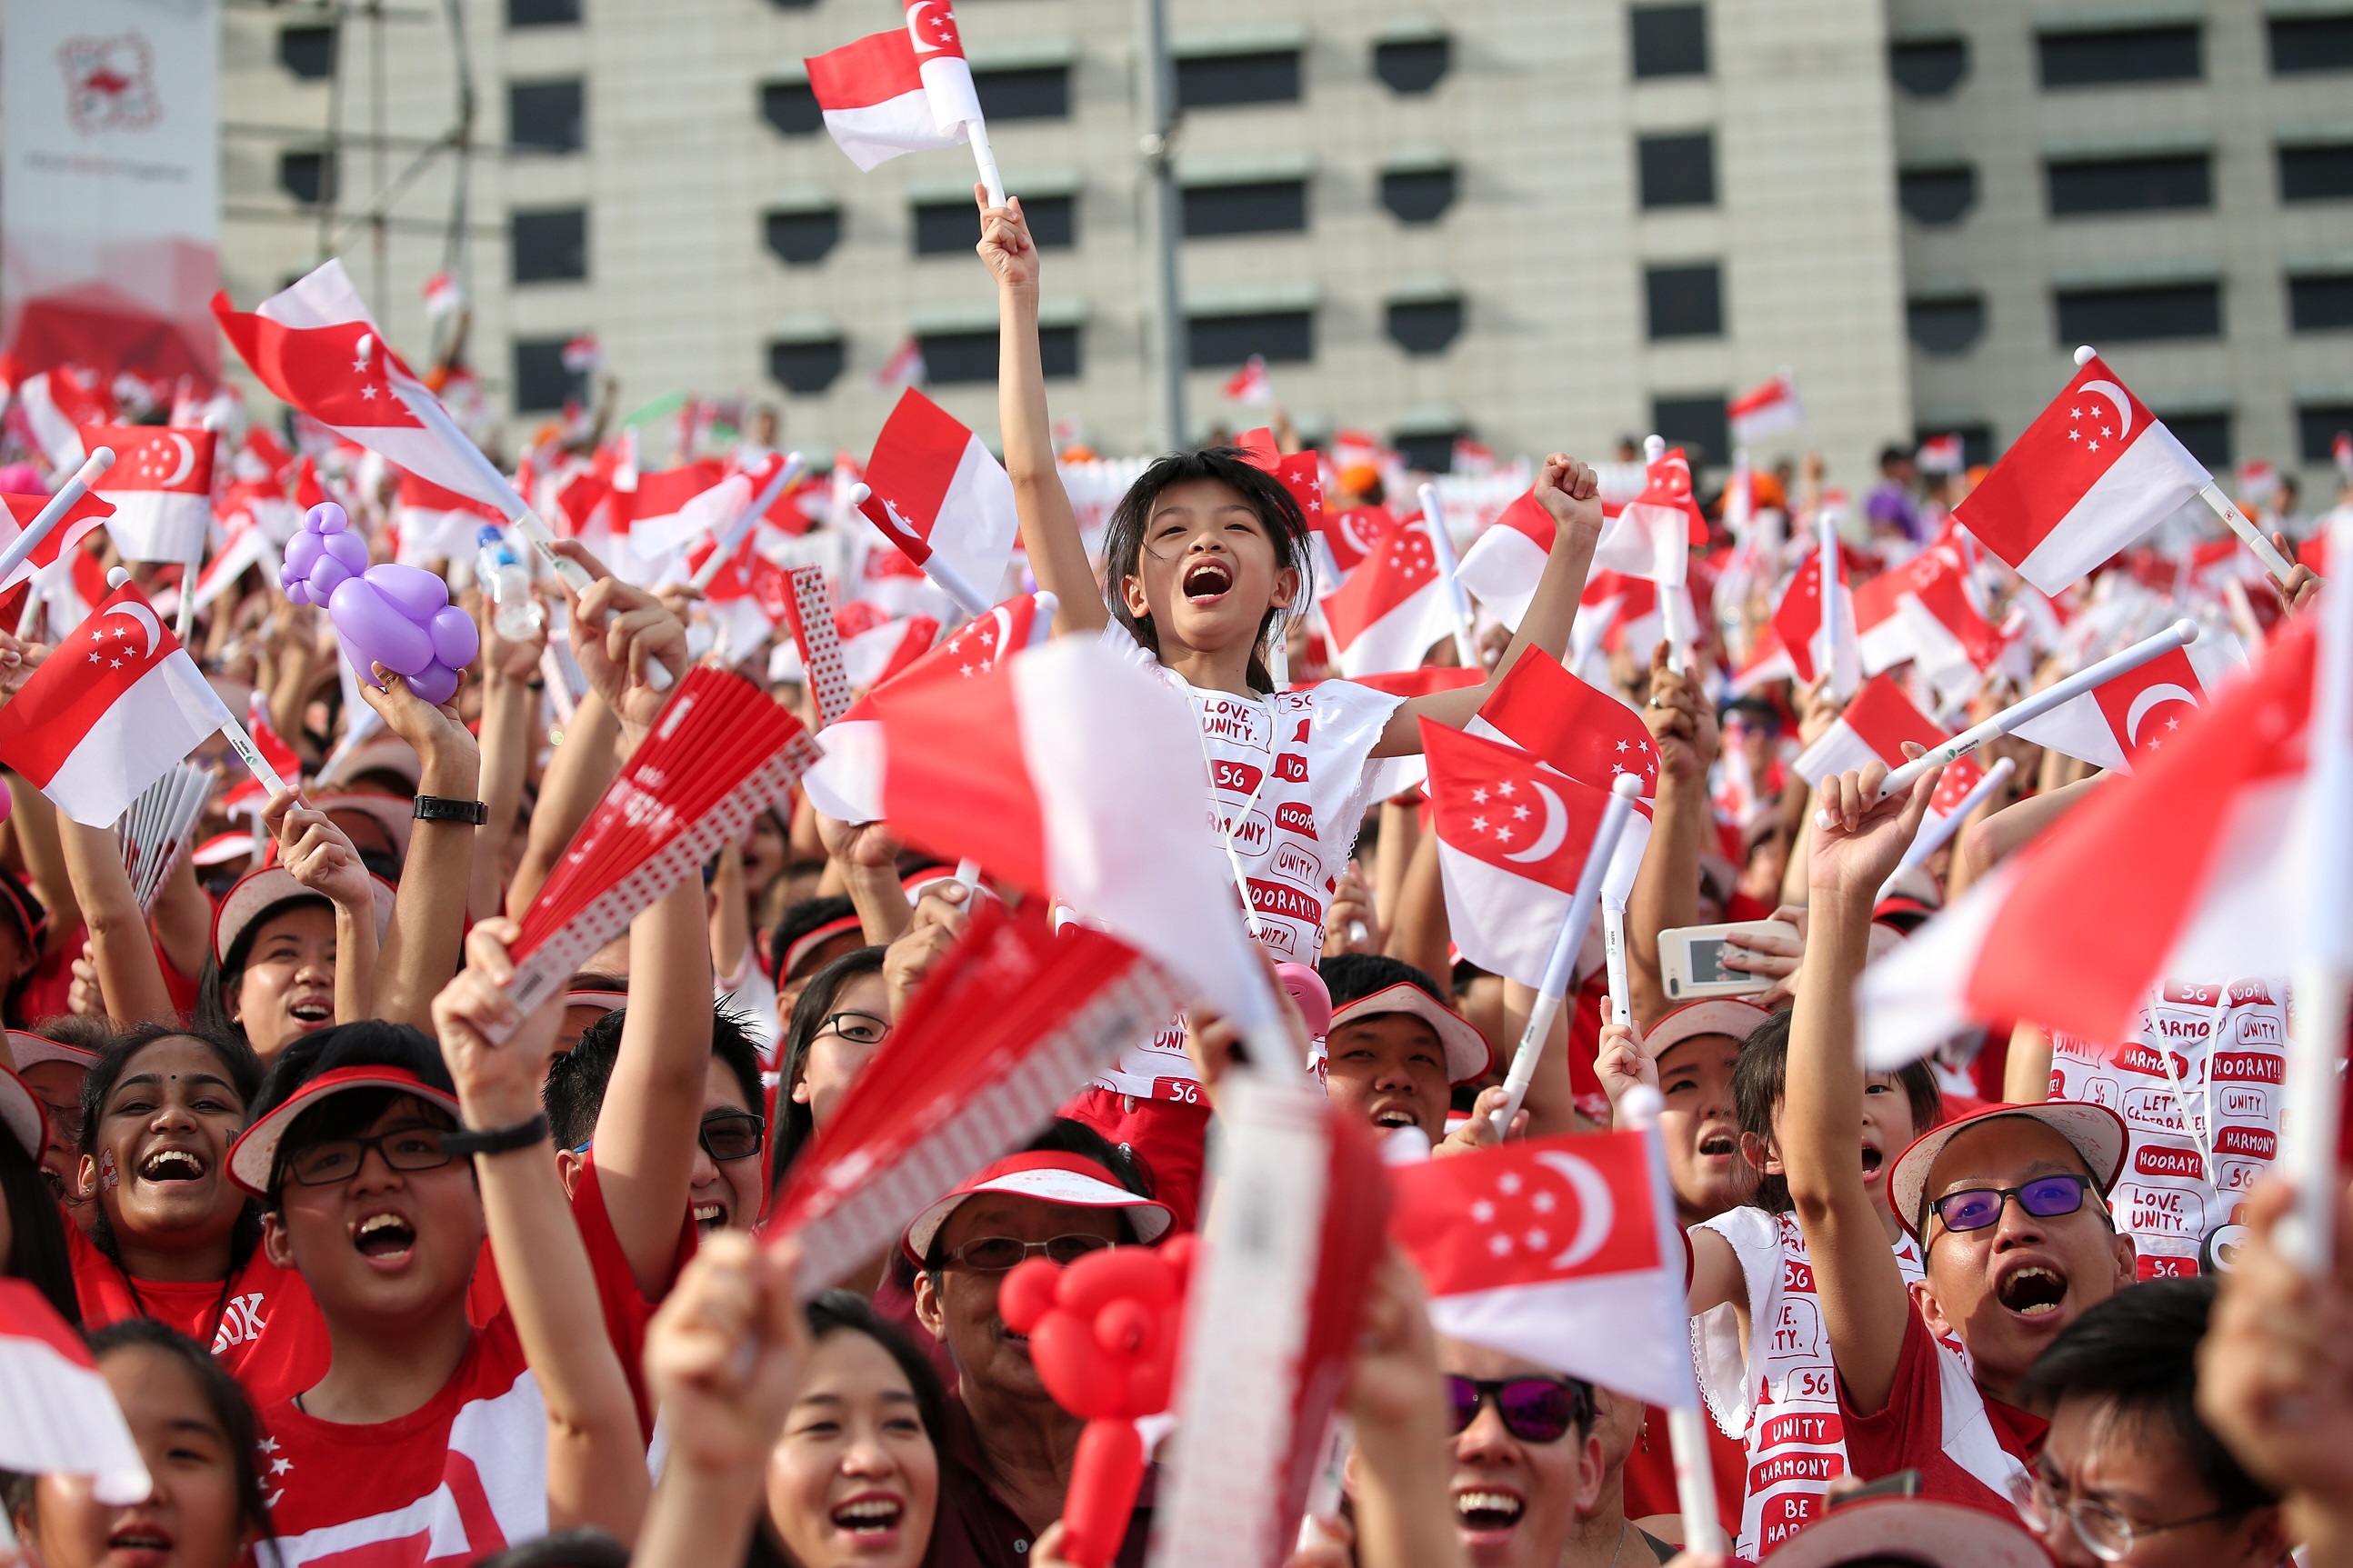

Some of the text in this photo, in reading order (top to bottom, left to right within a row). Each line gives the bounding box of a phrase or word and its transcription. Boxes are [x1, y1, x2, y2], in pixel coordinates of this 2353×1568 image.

[1205, 699, 1253, 724] LOVE.
[1202, 716, 1257, 742] UNITY.
[1957, 738, 1980, 754] sembcorp
[1217, 765, 1245, 787] SG
[1279, 851, 1312, 880] UNITY
[1249, 926, 1289, 945] NITY
[2181, 984, 2208, 1002] SG
[2243, 1022, 2276, 1039] UNITY
[2124, 1049, 2180, 1075] HARMOY
[2214, 1057, 2281, 1080] HOORAY!!
[1169, 1081, 1198, 1104] SG
[2228, 1094, 2261, 1111] UNITY
[2227, 1132, 2274, 1153] HARMONY
[2139, 1151, 2199, 1174] HOORAY!
[2229, 1167, 2254, 1188] SG
[2133, 1188, 2184, 1213] LOVE.
[2131, 1210, 2188, 1232] UNITY.
[1785, 1264, 1808, 1288] SG
[2152, 1260, 2179, 1278] SG
[1802, 1373, 1829, 1396] SG
[1773, 1417, 1826, 1443] UNITY
[1760, 1458, 1830, 1485] HARMONY
[1785, 1499, 1809, 1519] BE
